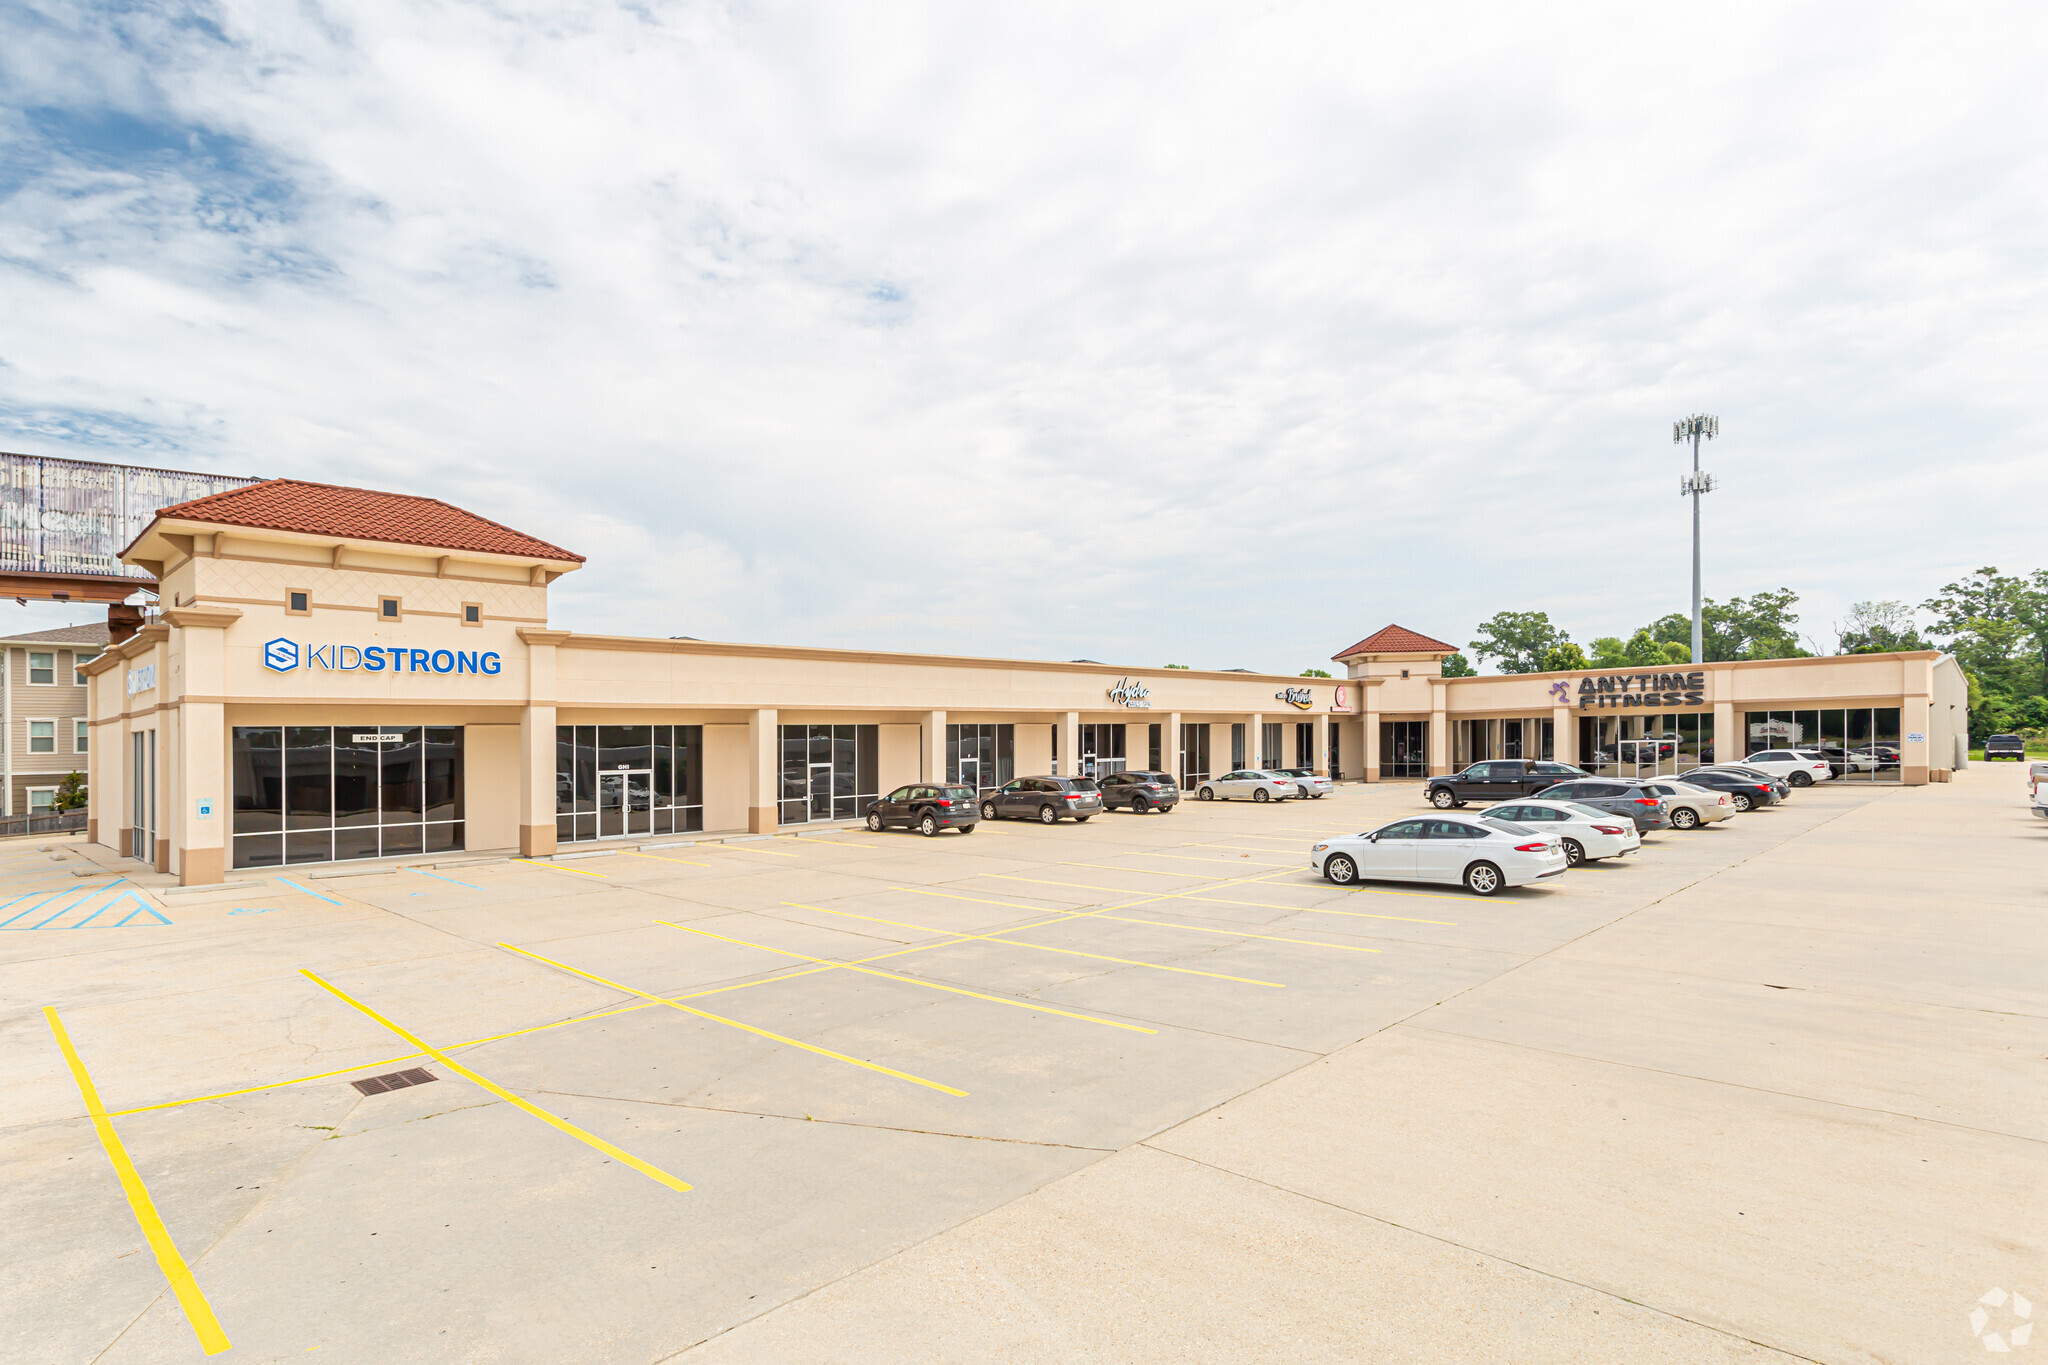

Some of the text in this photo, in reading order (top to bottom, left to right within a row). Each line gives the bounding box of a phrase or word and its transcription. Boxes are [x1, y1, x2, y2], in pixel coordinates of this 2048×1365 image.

[307, 643, 502, 676] KIDSTRONG
[1109, 676, 1151, 704] Hydro
[1578, 671, 1705, 694] ANYTIME
[1579, 690, 1705, 709] FITNESS
